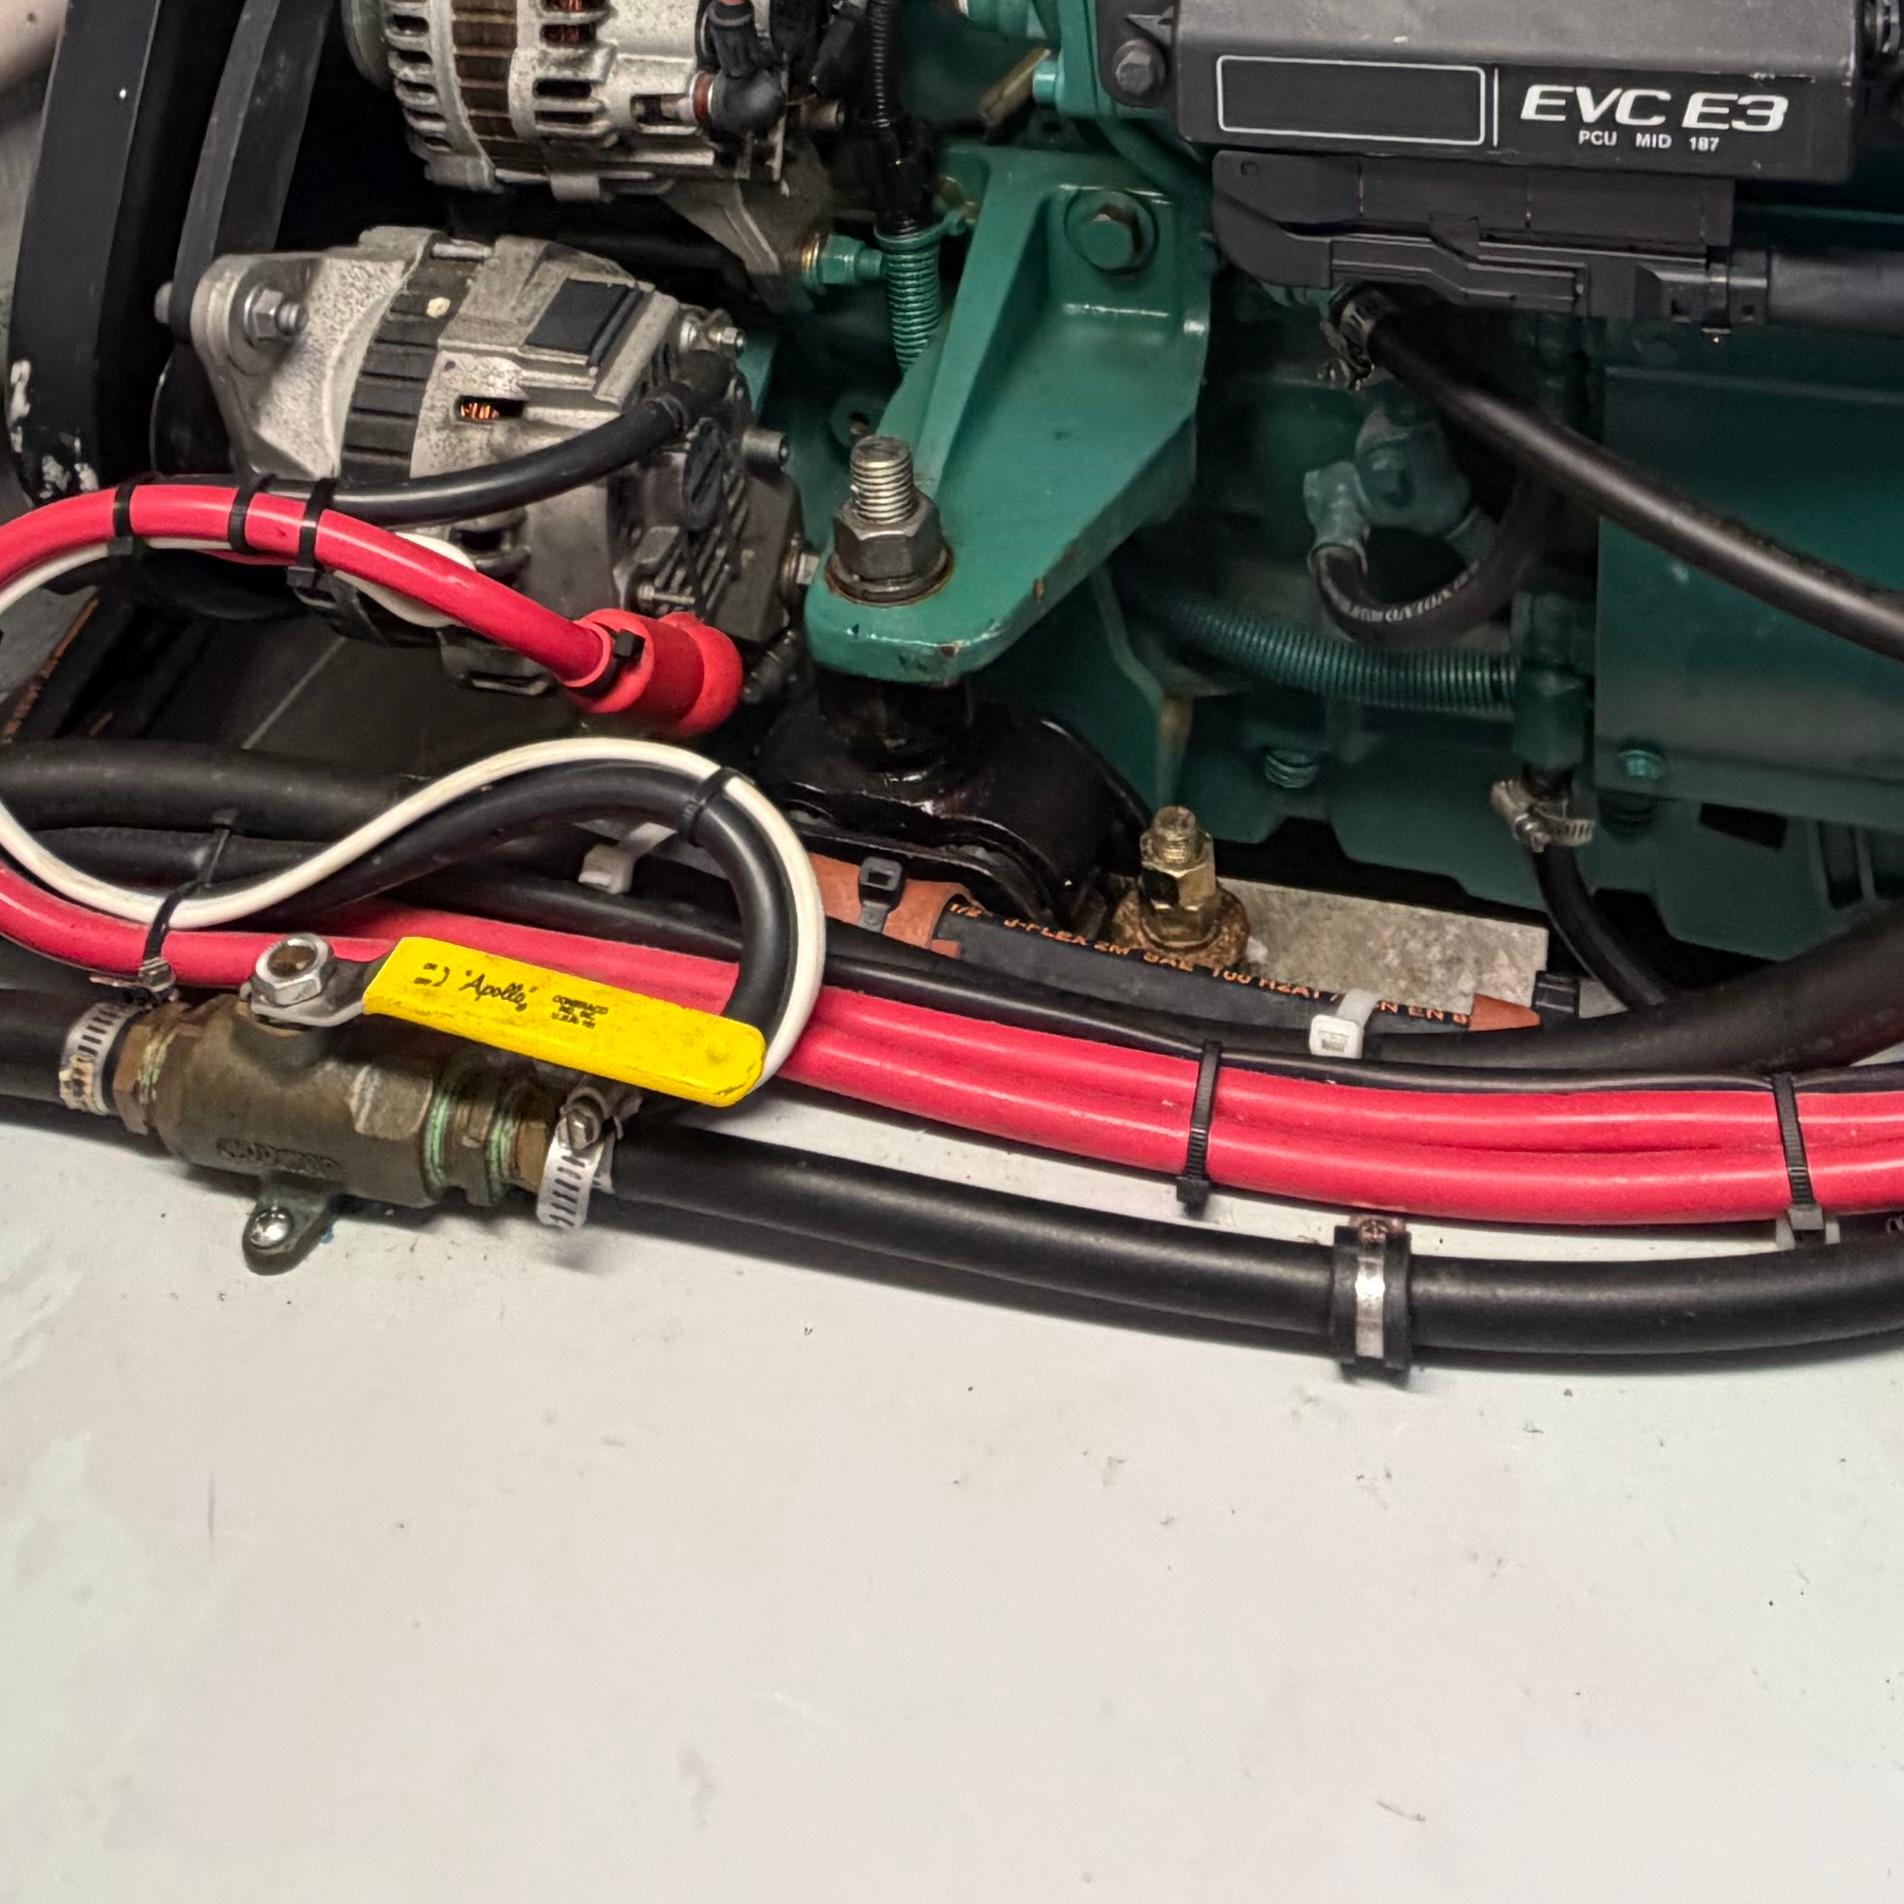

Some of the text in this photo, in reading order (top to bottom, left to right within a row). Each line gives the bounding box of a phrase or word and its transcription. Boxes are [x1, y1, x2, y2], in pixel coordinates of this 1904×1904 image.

[1520, 84, 1788, 133] EVC E3
[1578, 129, 1720, 153] PCU MID 187
